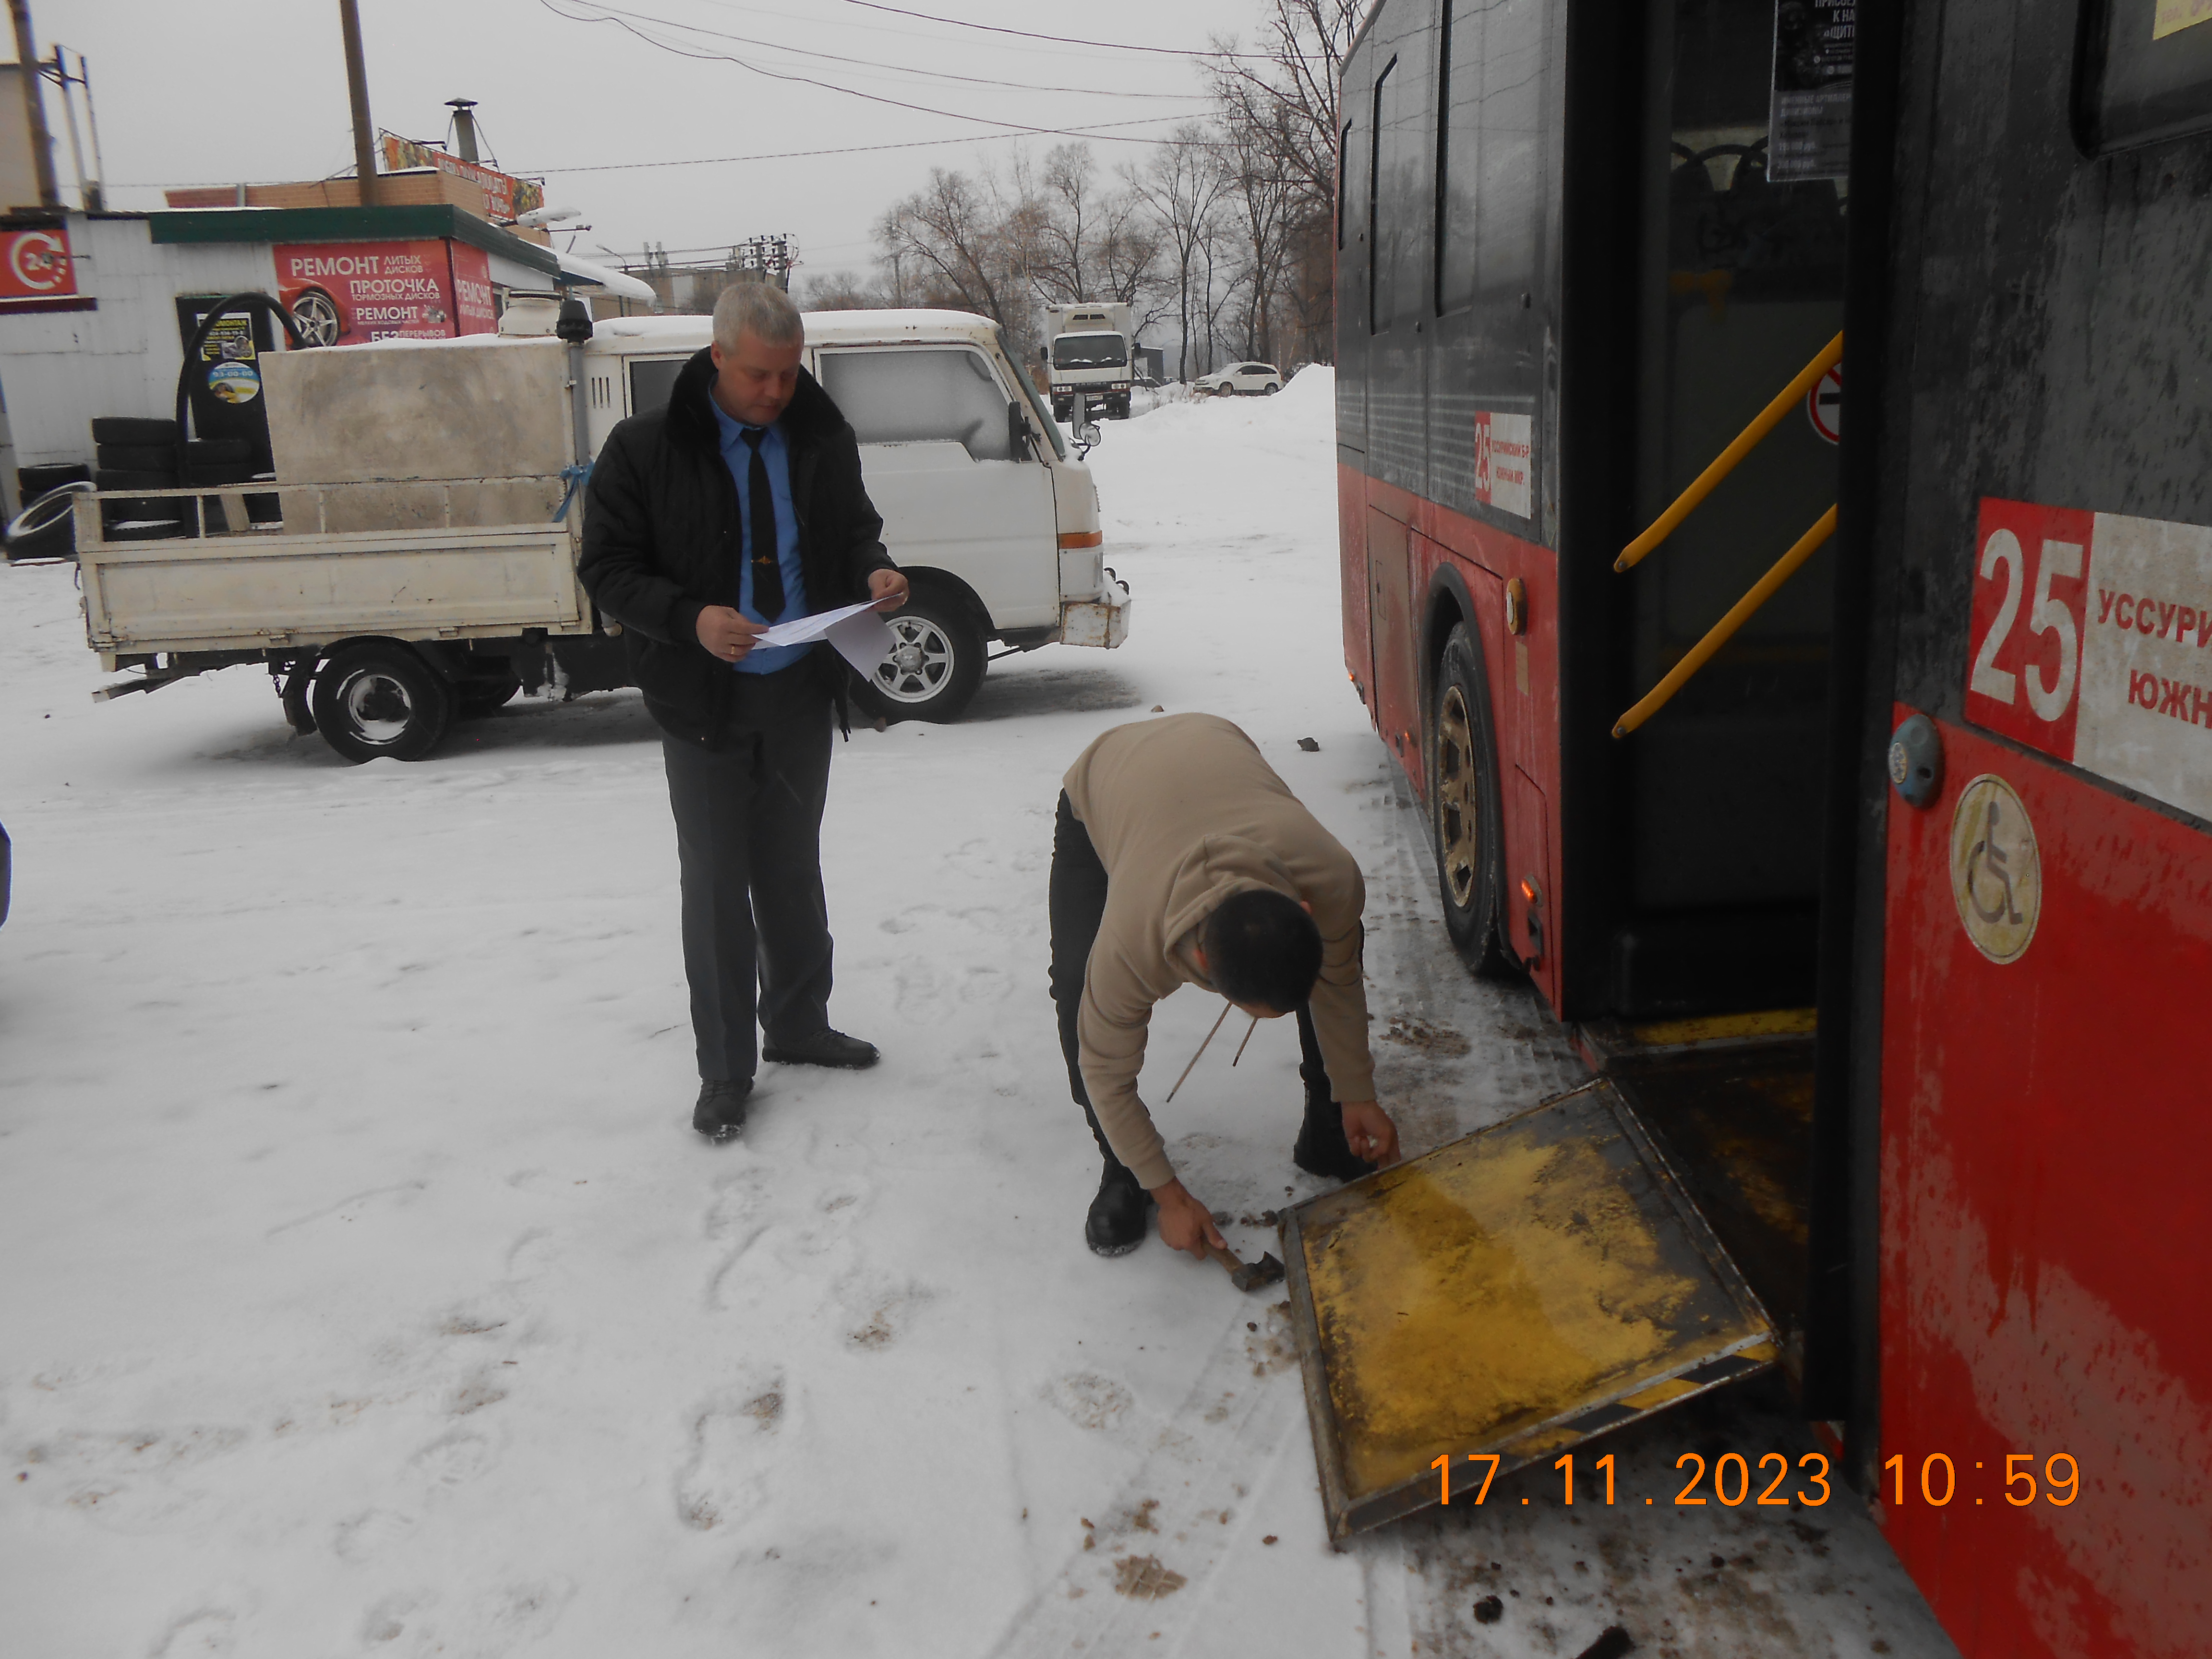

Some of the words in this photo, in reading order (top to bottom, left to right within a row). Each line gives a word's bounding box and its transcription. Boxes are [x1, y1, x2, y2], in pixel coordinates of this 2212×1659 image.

[1833, 10, 1839, 22] К
[291, 256, 379, 276] РЕМОНТ
[384, 255, 421, 265] ЛИТЫХ
[385, 265, 424, 274] ДИСКОВ
[350, 278, 439, 293] ПРОТОЧКА
[457, 279, 492, 305] РЕМОНТ
[356, 306, 418, 320] РЕМОНТ
[1475, 422, 1490, 492] 25
[1971, 529, 2083, 721] 25
[2098, 589, 2212, 648] УССУРИ
[2128, 670, 2212, 729] ЮЖН
